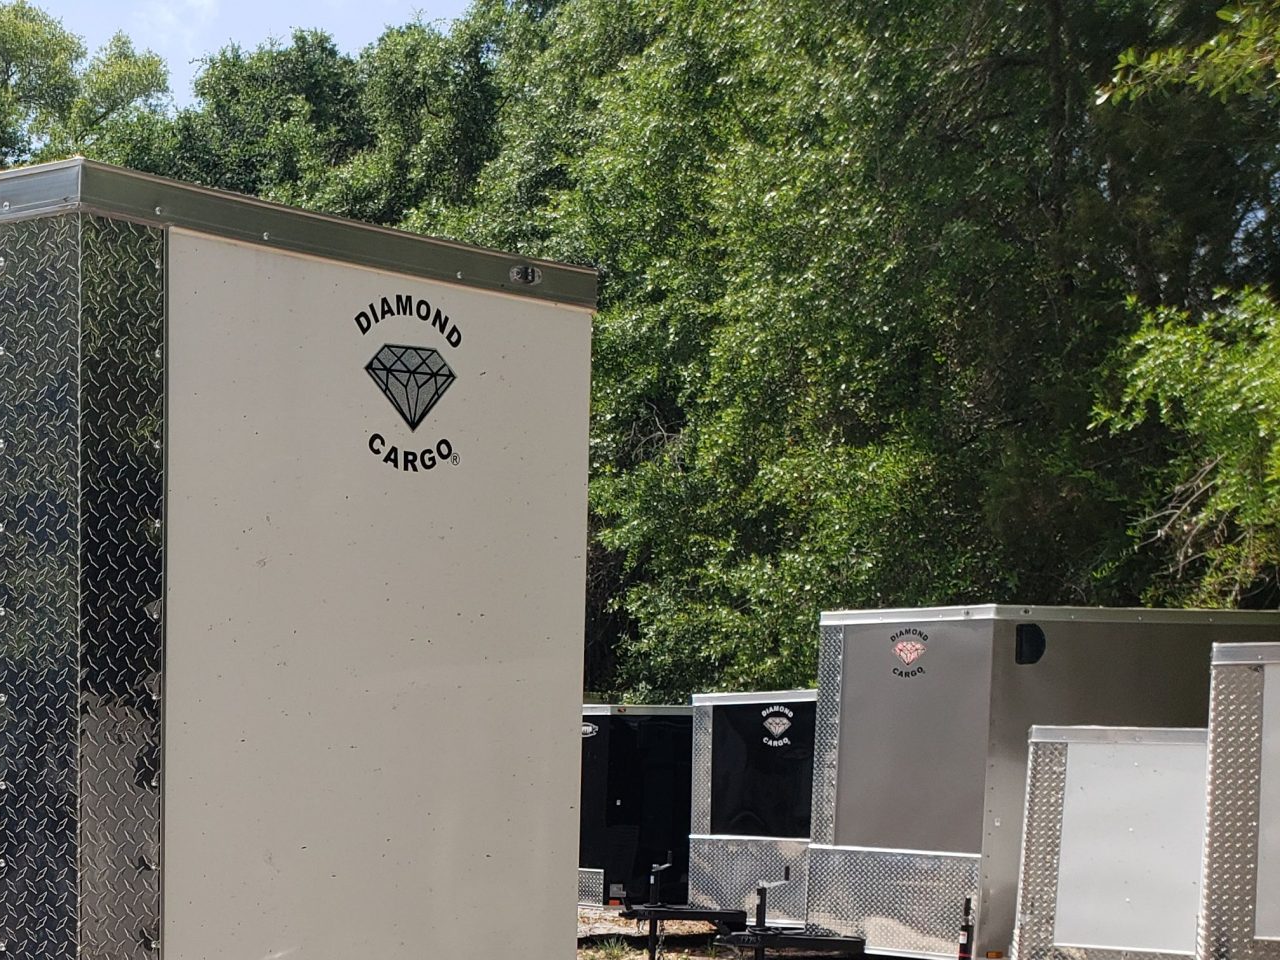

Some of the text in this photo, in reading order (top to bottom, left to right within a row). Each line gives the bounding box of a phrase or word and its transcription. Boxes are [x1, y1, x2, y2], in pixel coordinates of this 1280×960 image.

[354, 294, 462, 348] DIAMOND
[890, 628, 929, 642] DIAMOND
[761, 705, 794, 718] DIAMOND
